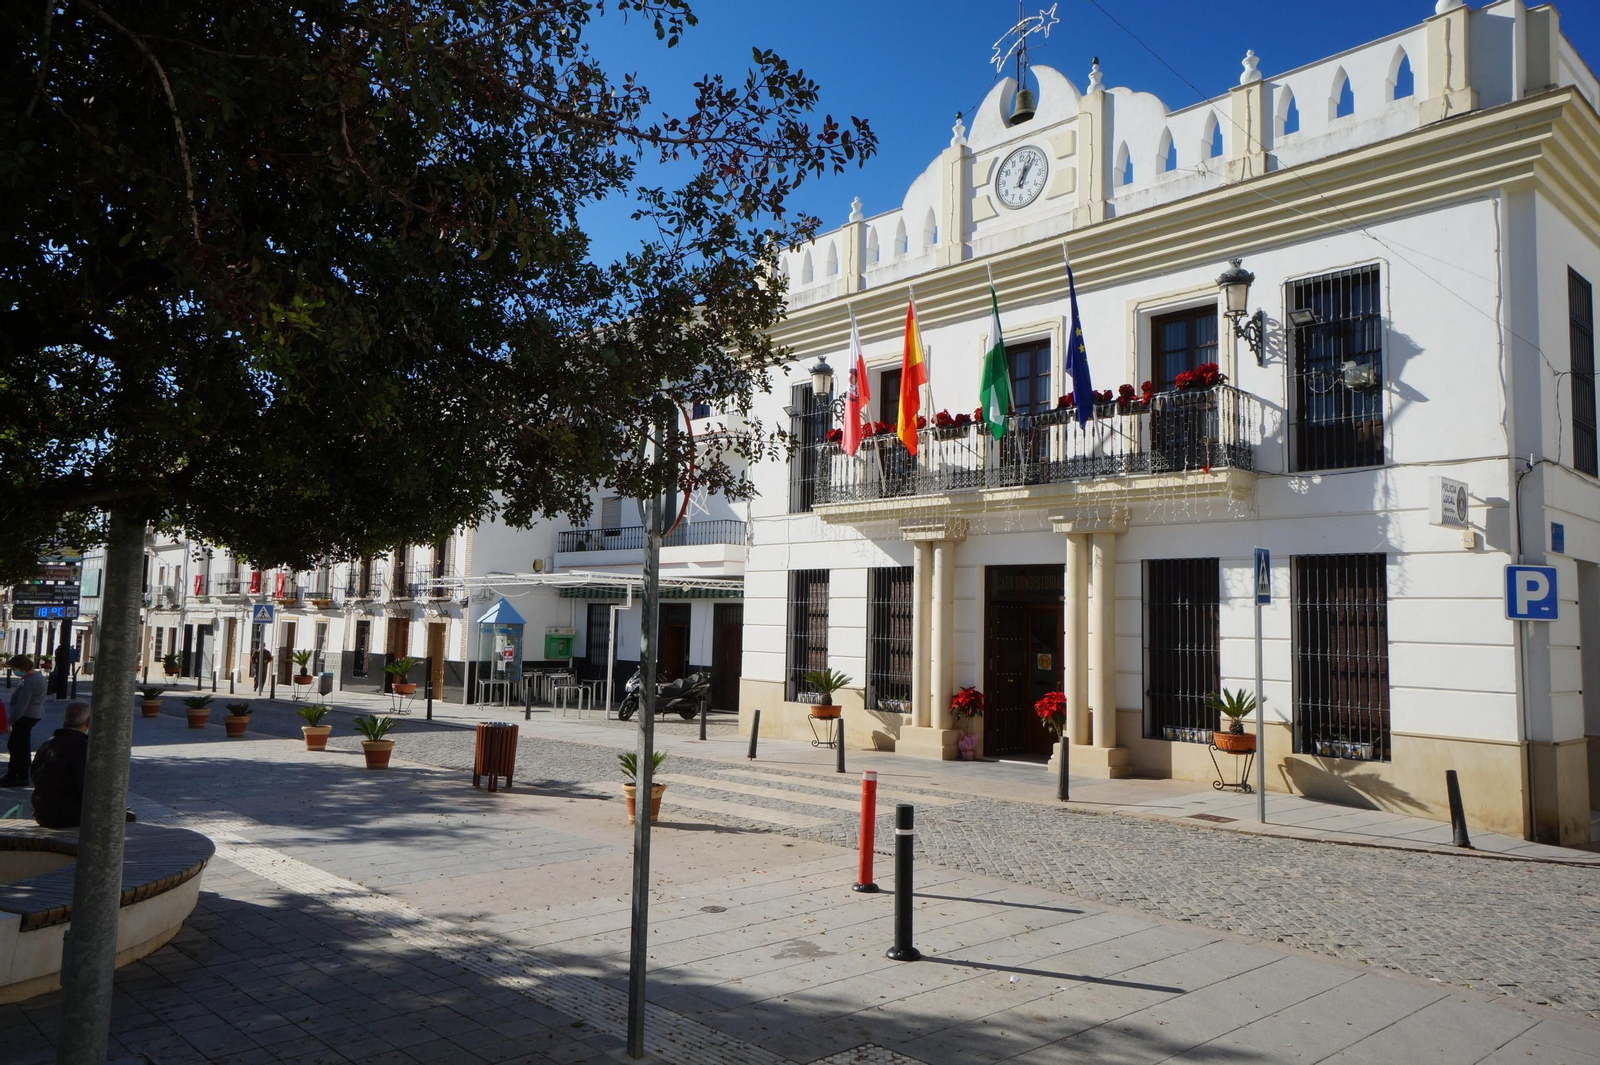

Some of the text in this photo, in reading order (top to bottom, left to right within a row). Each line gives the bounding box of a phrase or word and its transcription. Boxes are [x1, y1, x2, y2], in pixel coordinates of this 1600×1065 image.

[1442, 482, 1457, 494] POLICIA
[1443, 495, 1456, 505] LOCAL
[997, 575, 1014, 591] CASA
[1515, 570, 1550, 615] P
[38, 607, 48, 617] 18
